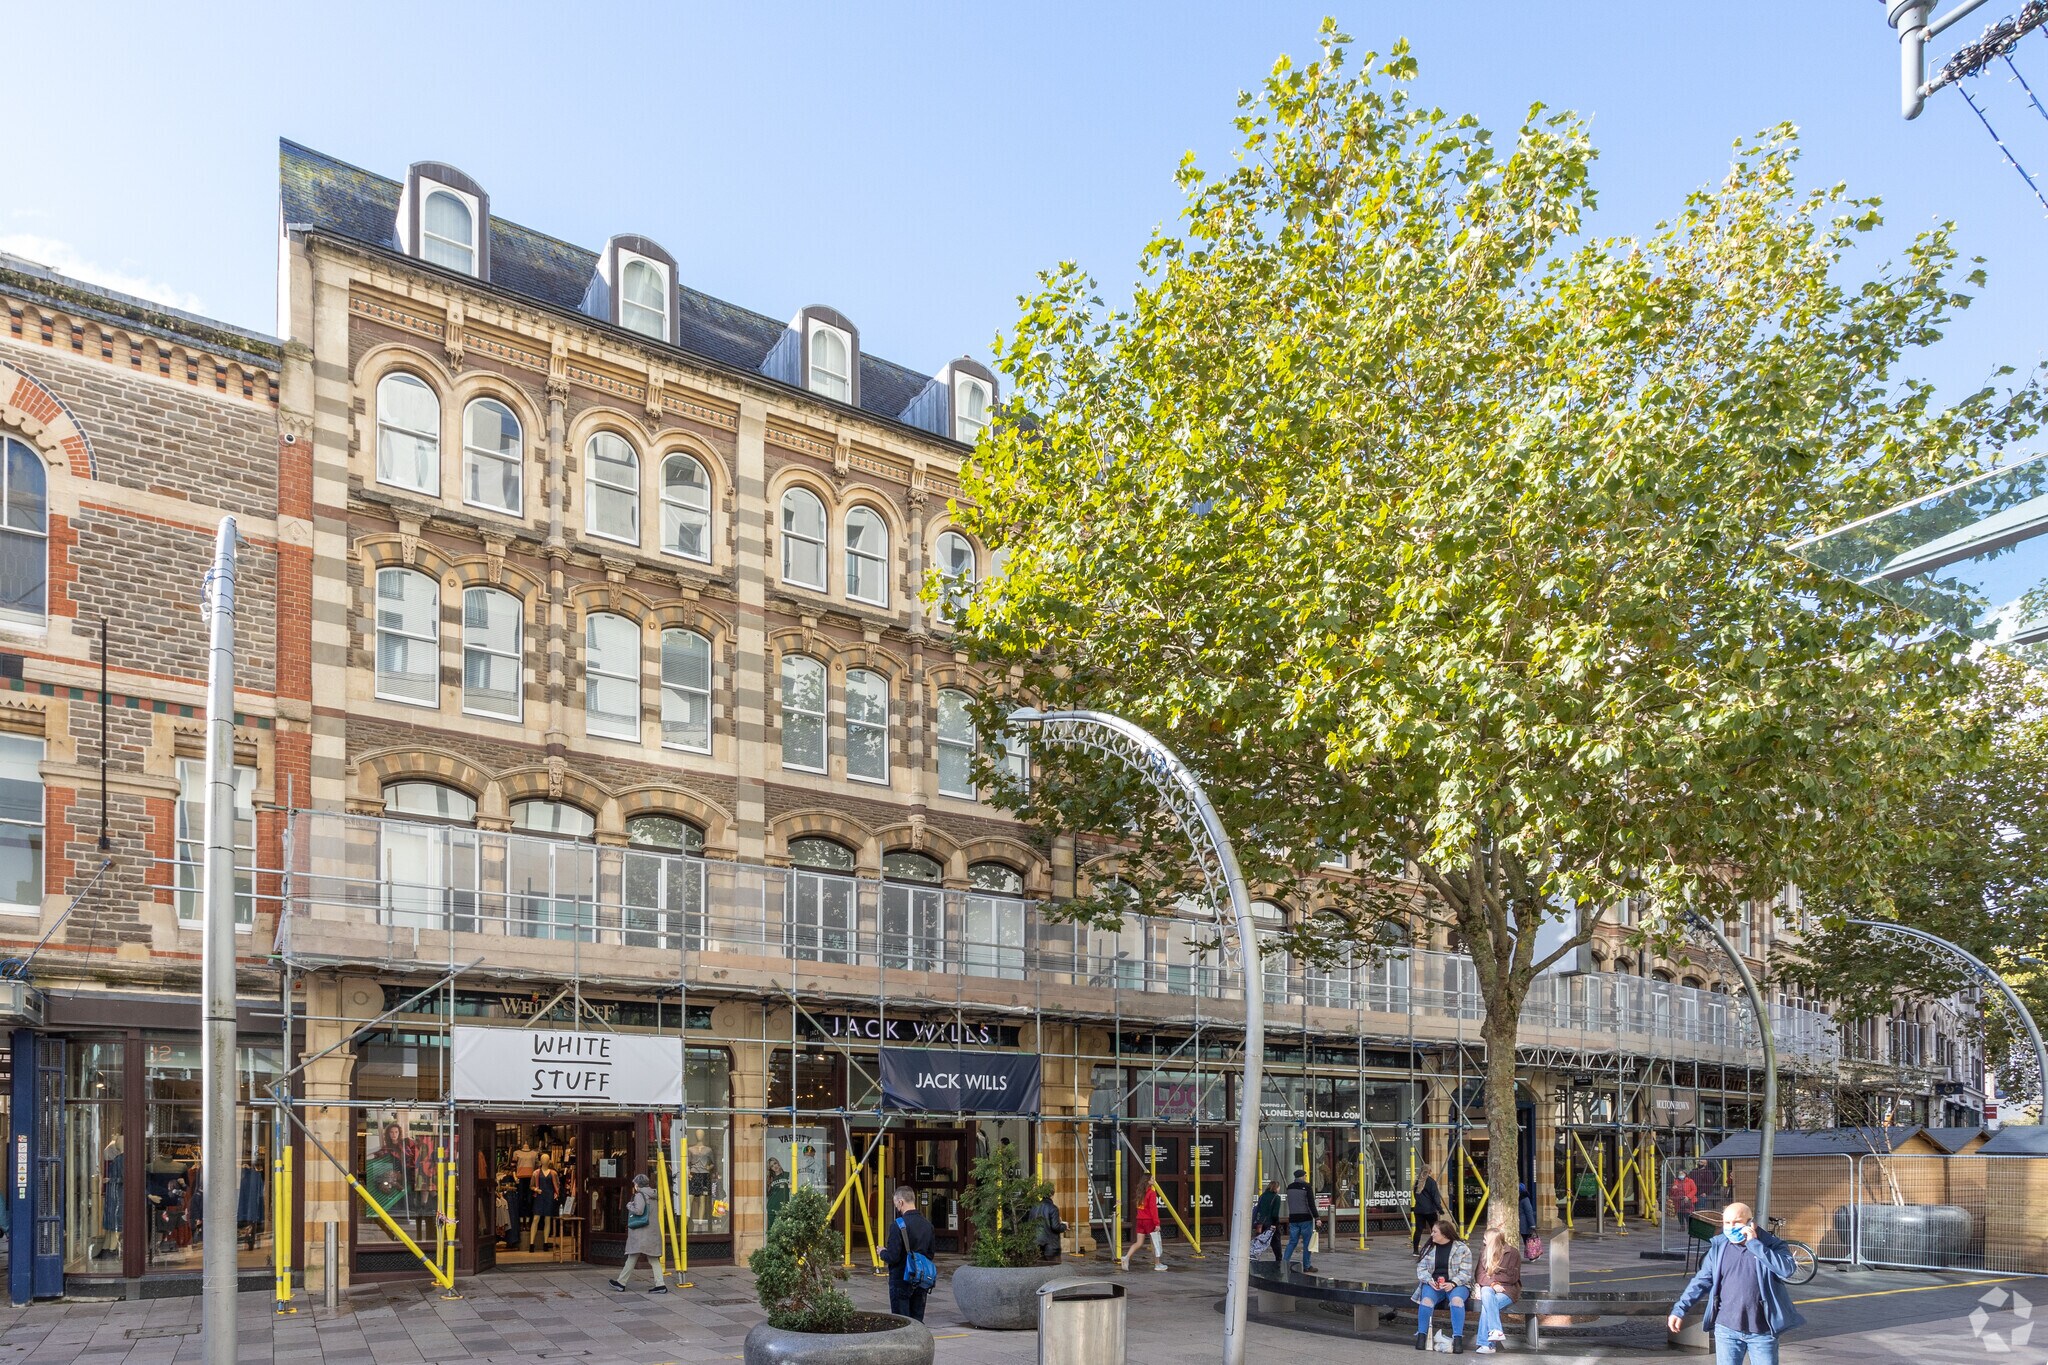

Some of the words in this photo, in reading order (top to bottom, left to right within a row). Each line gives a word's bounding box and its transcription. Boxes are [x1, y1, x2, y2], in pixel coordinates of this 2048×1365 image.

[832, 1016, 900, 1039] JACK
[913, 1022, 989, 1044] WILLS
[534, 1034, 611, 1057] WHITE
[532, 1069, 610, 1091] STUFF
[915, 1072, 961, 1090] JACK
[965, 1074, 1008, 1091] WILLS
[1680, 1073, 1707, 1088] URBN
[778, 1133, 813, 1144] VARSITY
